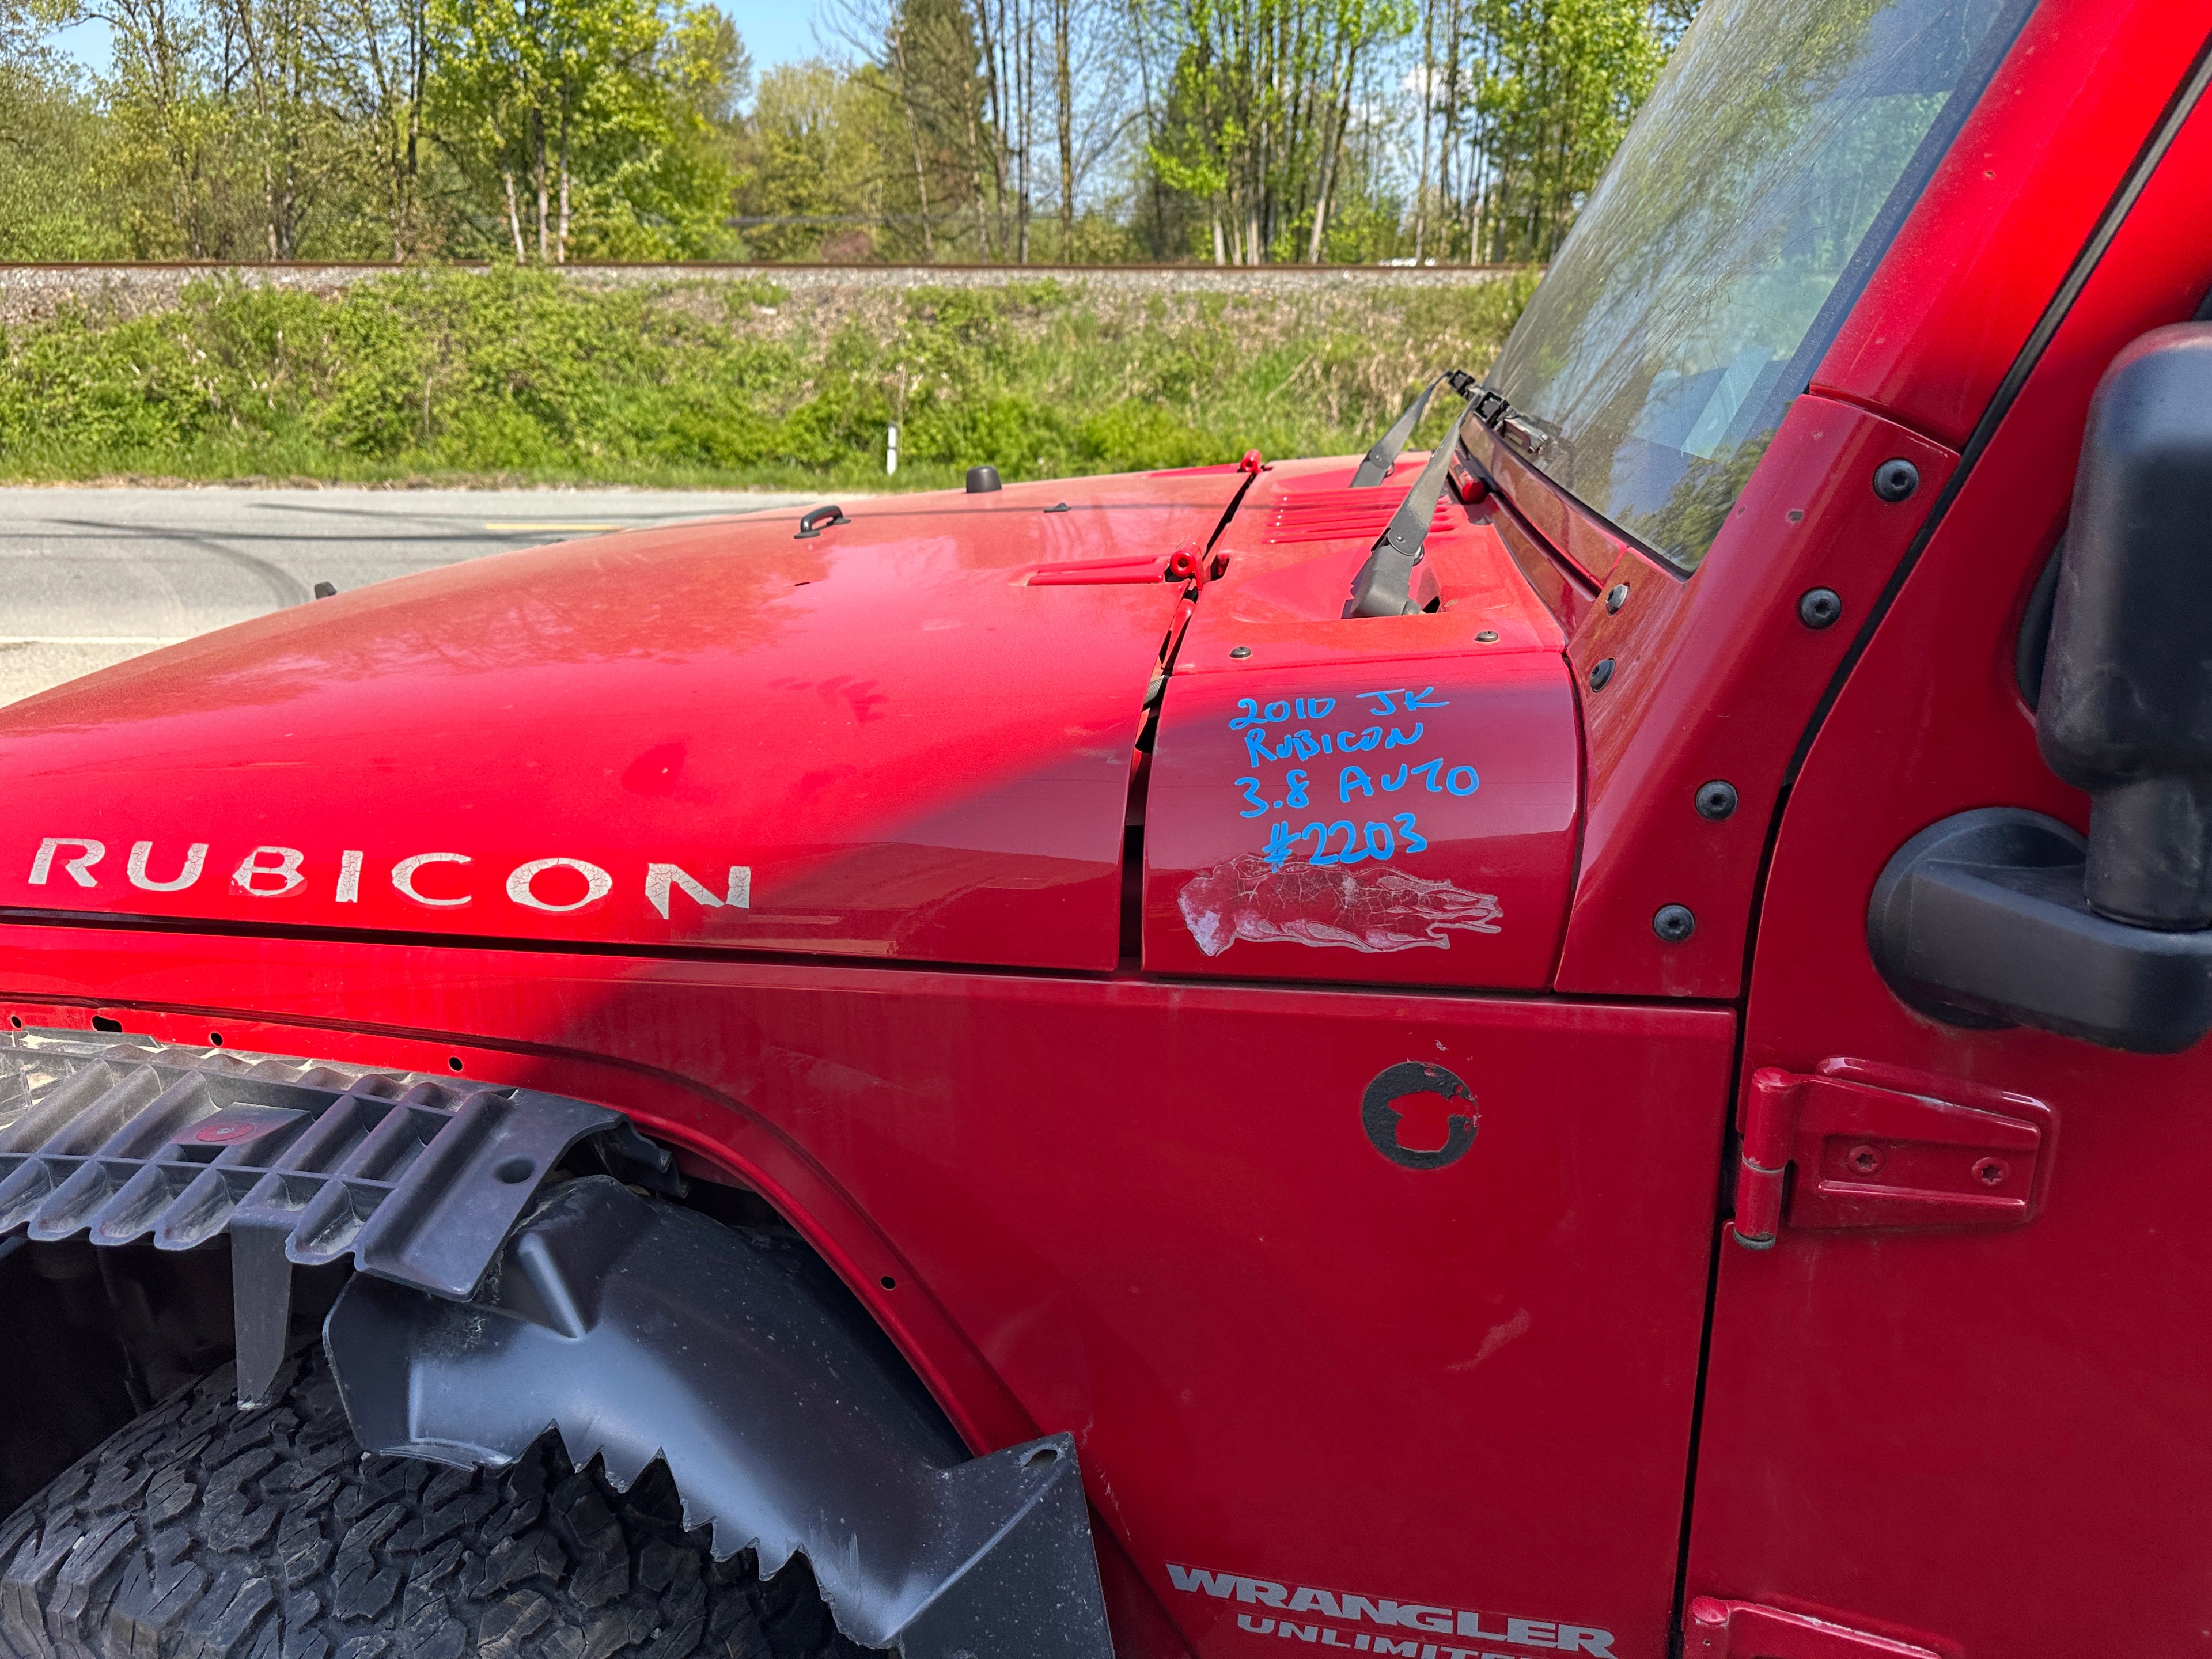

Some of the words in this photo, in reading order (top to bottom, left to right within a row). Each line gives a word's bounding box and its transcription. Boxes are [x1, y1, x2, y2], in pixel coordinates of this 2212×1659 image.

[1228, 697, 1336, 730] 2010
[1357, 686, 1449, 716] JK
[1244, 722, 1424, 768] RUBICON
[1235, 769, 1309, 818] 3.8
[1339, 757, 1480, 803] AUTO
[1262, 812, 1428, 873] #2203
[28, 837, 752, 920] RUBICON
[1165, 1563, 1619, 1659] WRANGLER
[1236, 1613, 1532, 1659] UNLIMIT
